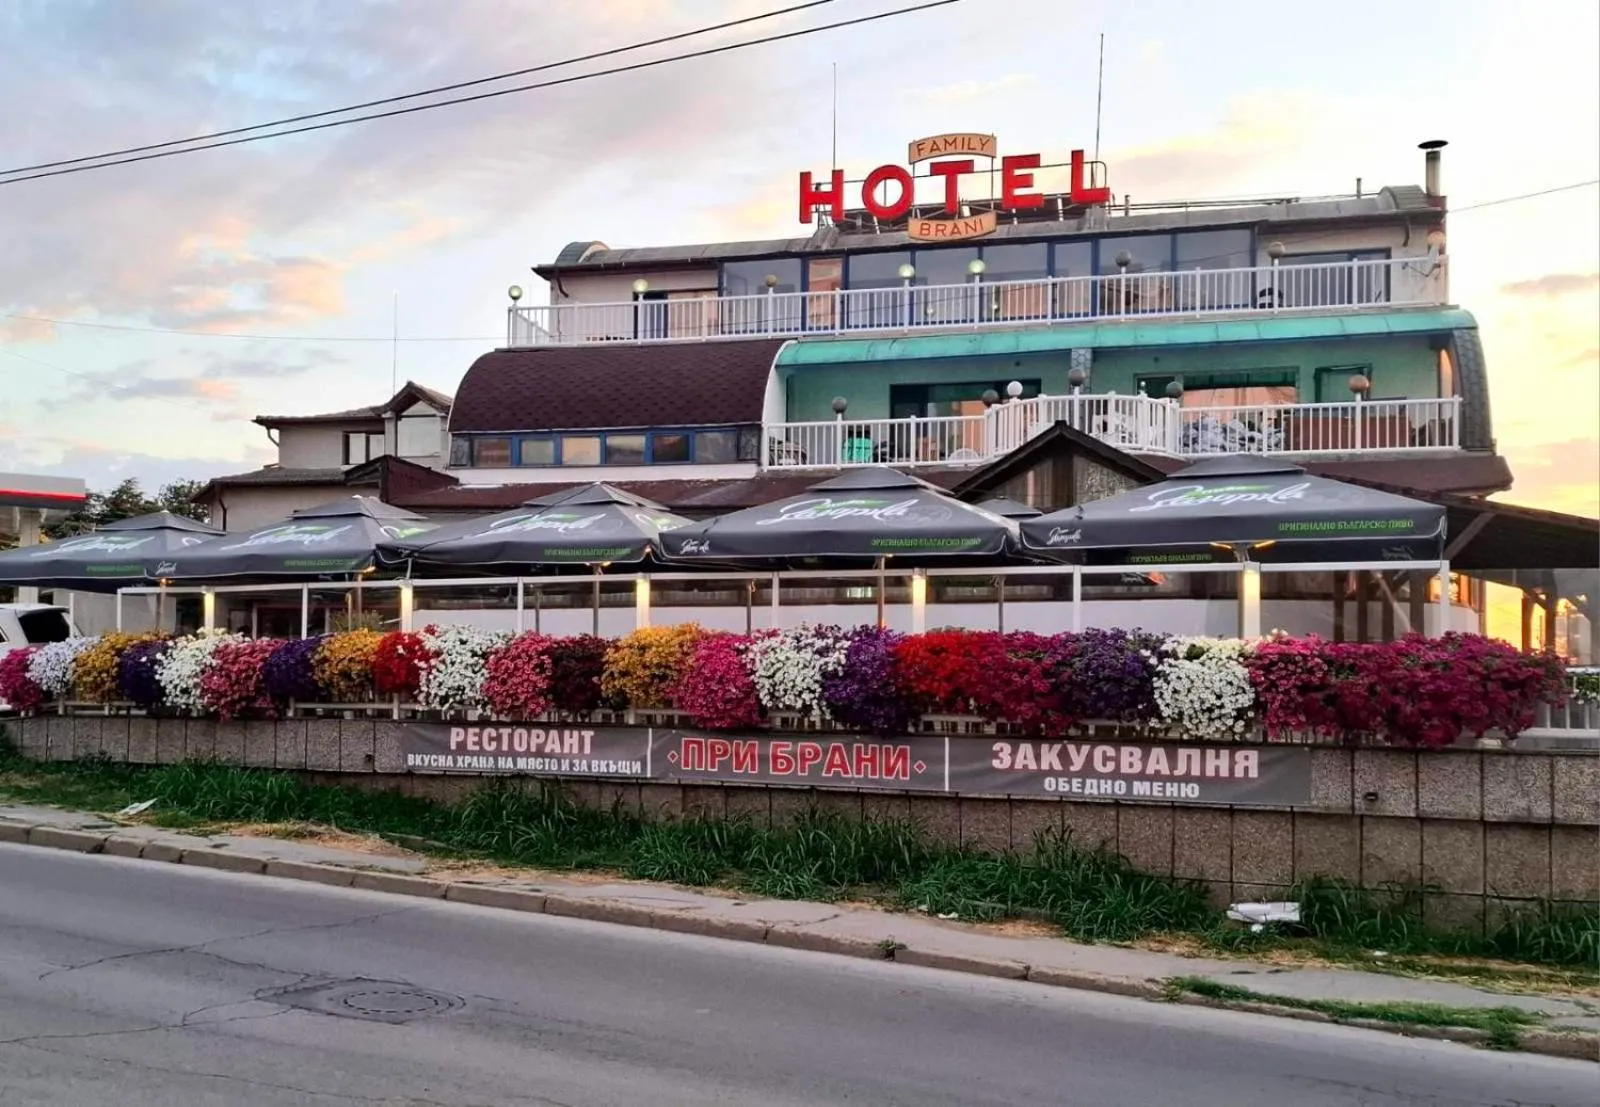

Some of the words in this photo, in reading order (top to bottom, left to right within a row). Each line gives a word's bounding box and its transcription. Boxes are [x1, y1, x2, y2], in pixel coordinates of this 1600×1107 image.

[916, 135, 991, 157] FAMILY
[799, 149, 1110, 224] HOTEL
[919, 218, 985, 237] BRANI
[450, 727, 595, 754] РЕСТОРАНТ
[407, 753, 453, 768] ВКУСНА
[456, 755, 494, 769] ХРАНА
[498, 756, 514, 770] НА
[517, 757, 558, 771] МЯСТО
[560, 758, 570, 771] И
[573, 759, 587, 772] ЗА
[591, 760, 641, 774] ВКЪЩИ
[681, 737, 759, 774] ПРИ
[769, 741, 911, 780] БРАНИ
[991, 742, 1259, 778] ЗАКУСВАЛНЯ
[1044, 777, 1127, 795] ОБЕДНО
[1132, 781, 1199, 798] МЕНЮ
